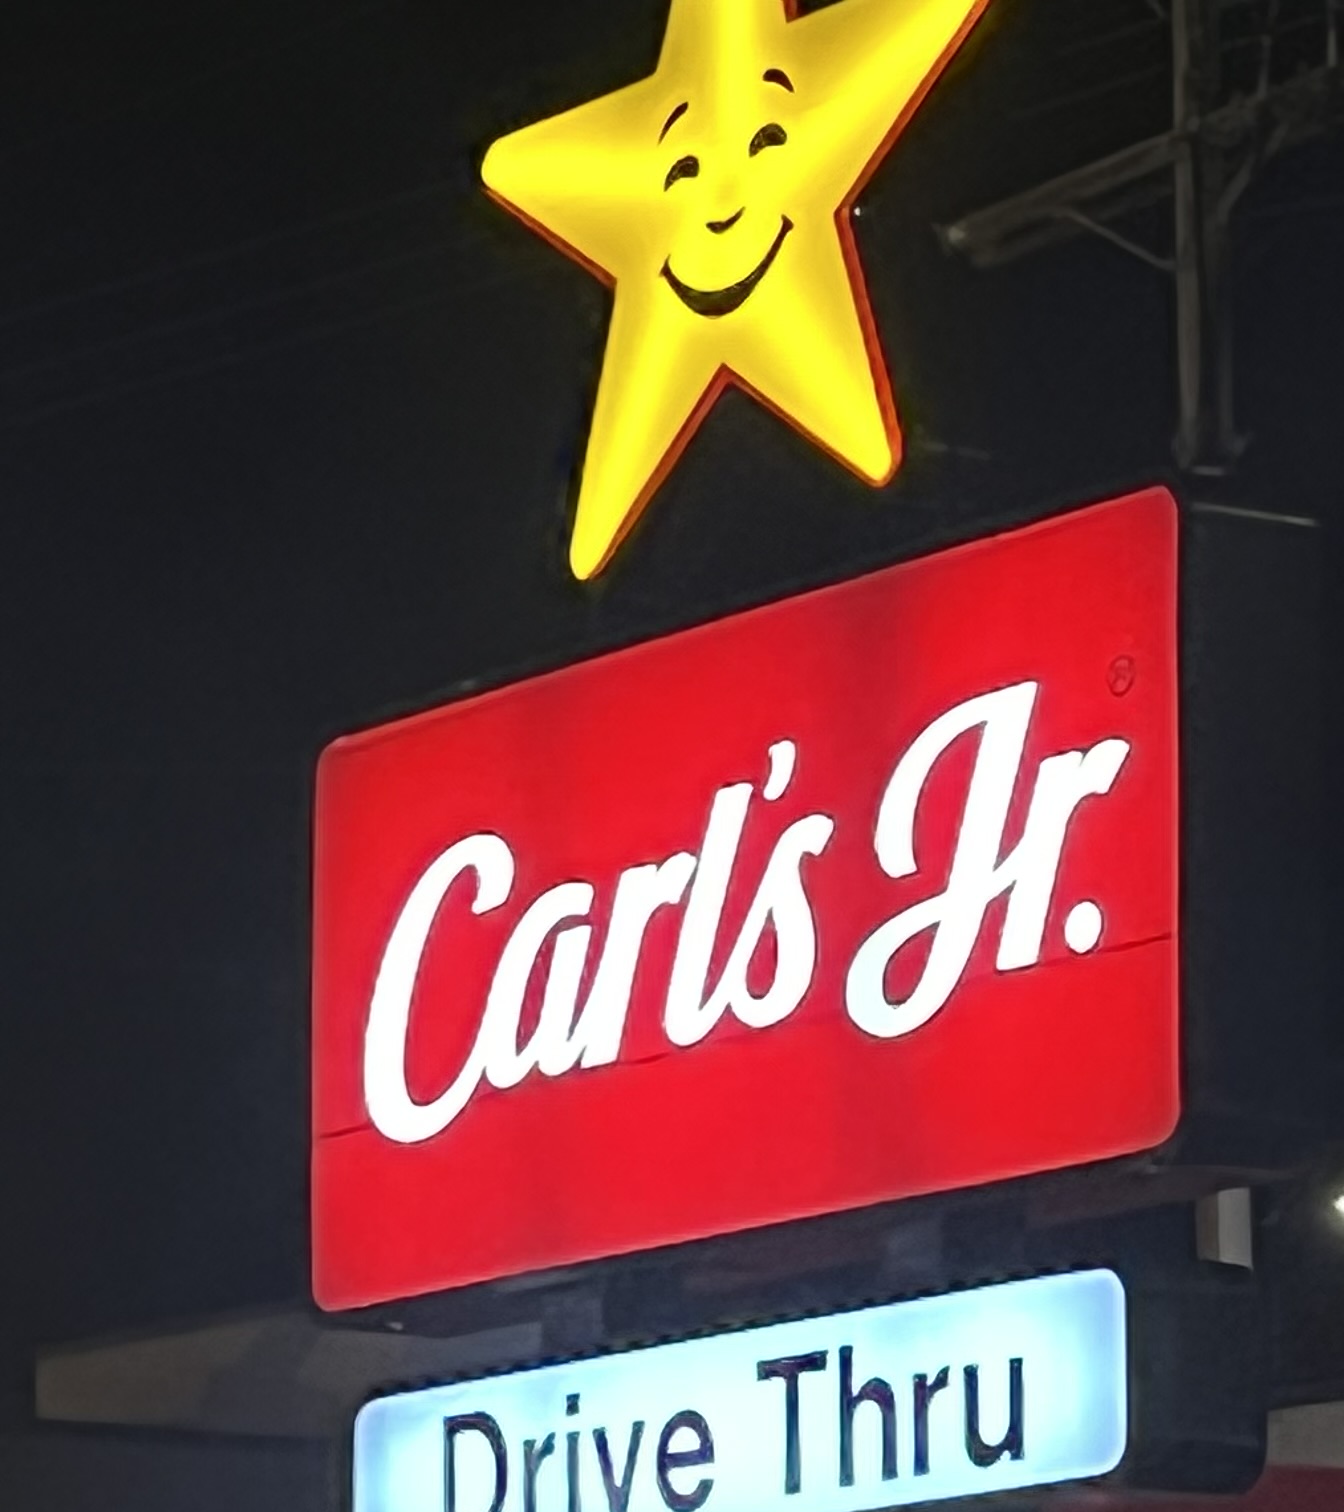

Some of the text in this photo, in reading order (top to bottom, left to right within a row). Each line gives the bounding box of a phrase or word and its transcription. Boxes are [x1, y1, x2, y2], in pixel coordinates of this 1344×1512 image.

[362, 678, 1131, 1145] Carl's Jr.
[755, 1343, 1027, 1494] Thru
